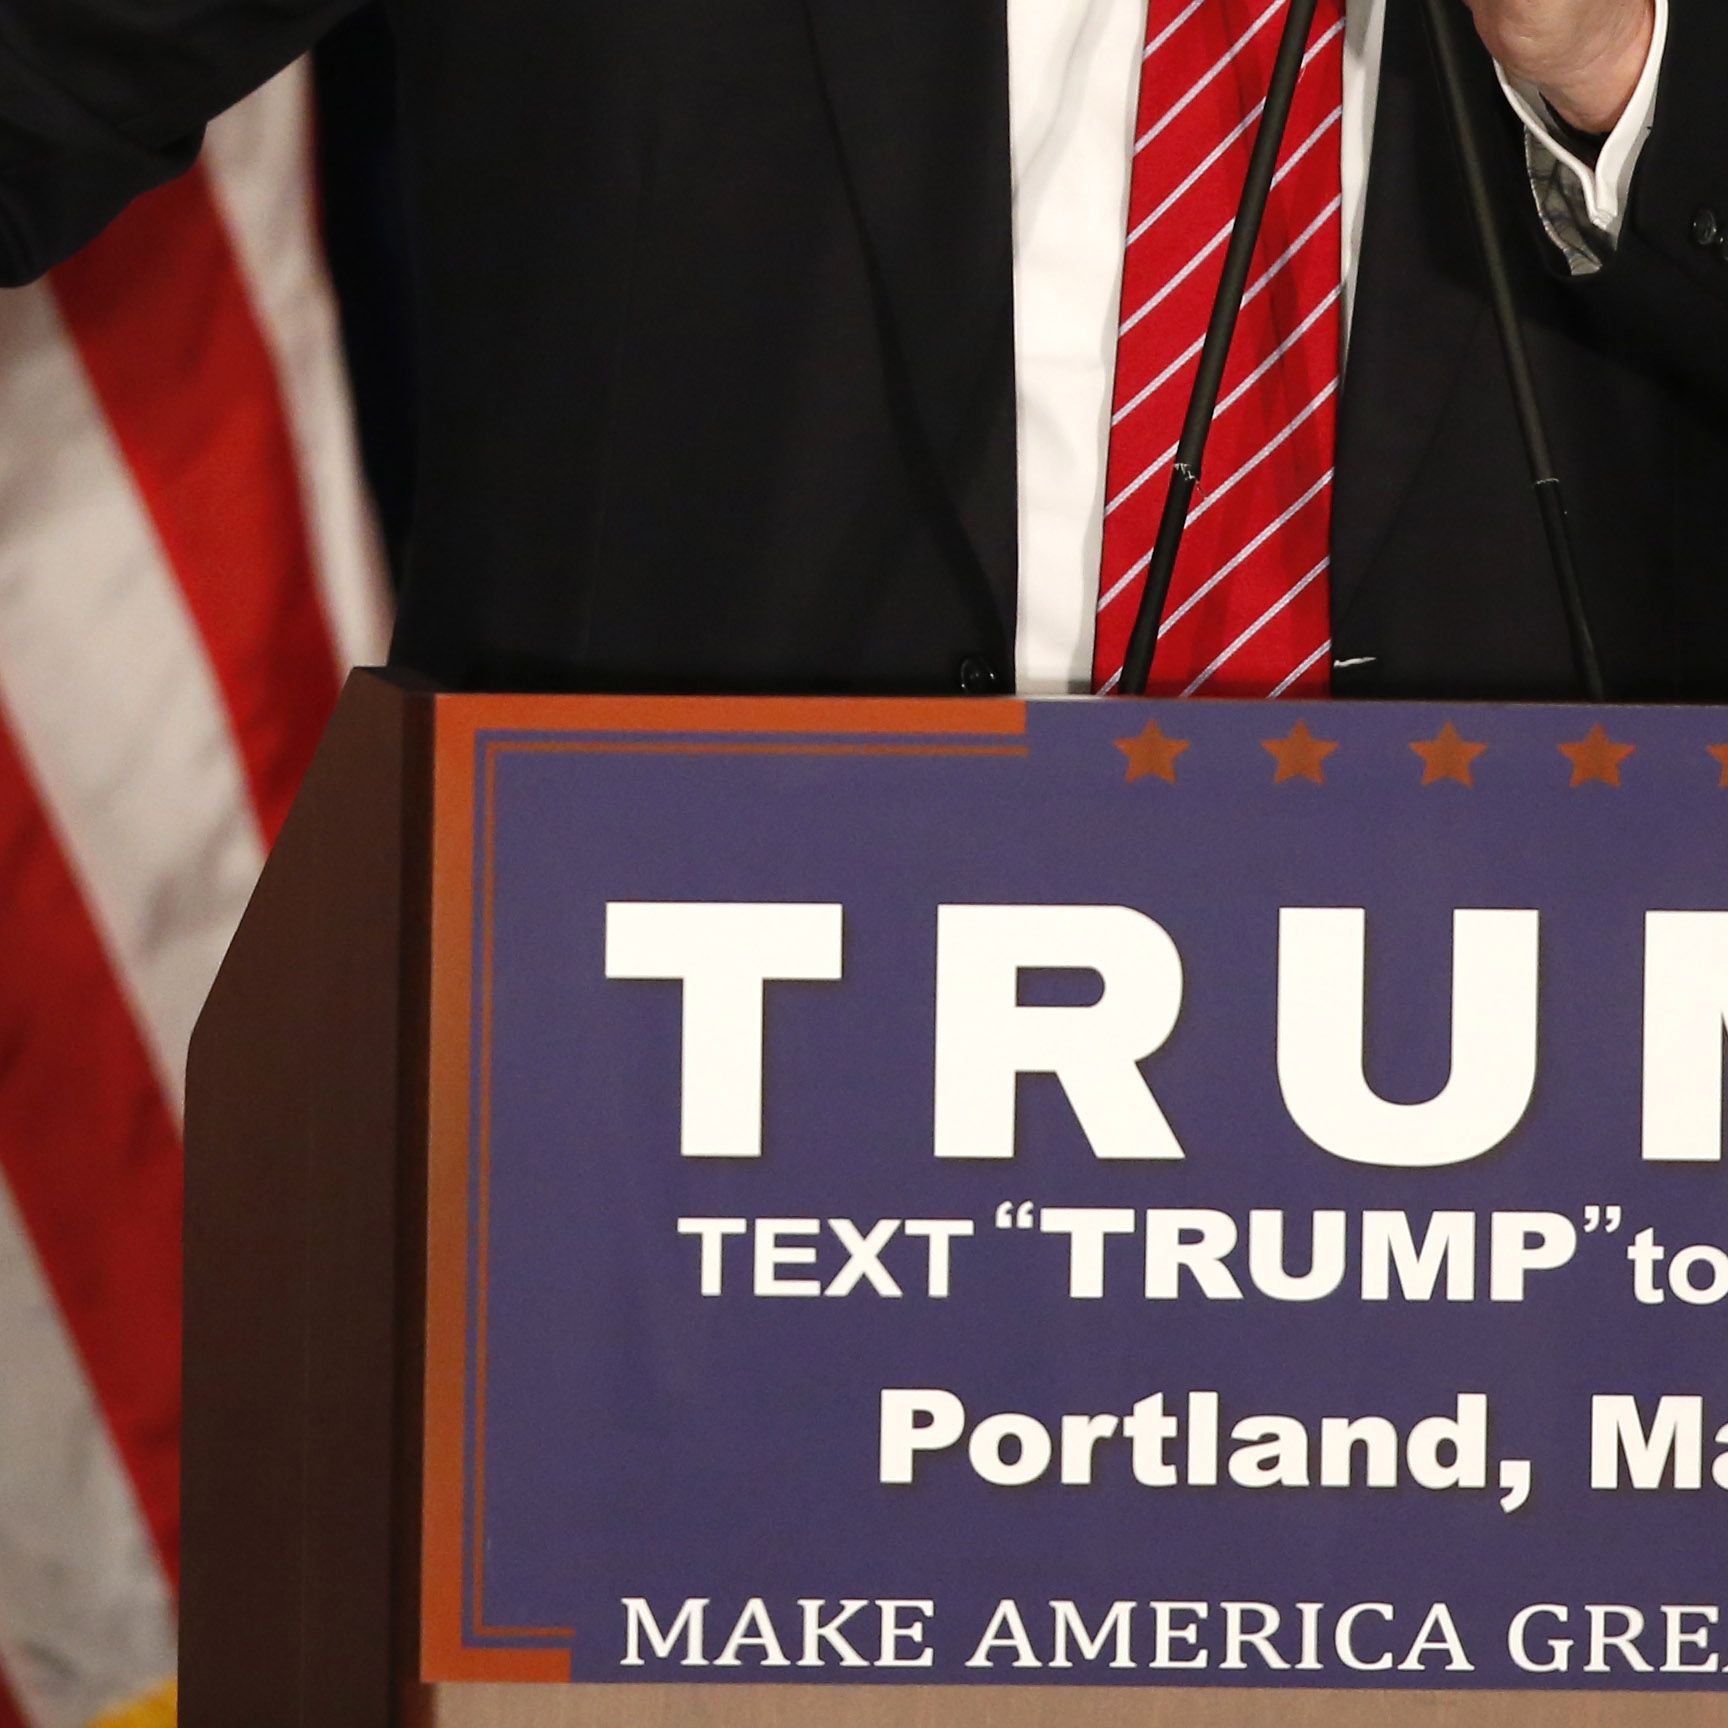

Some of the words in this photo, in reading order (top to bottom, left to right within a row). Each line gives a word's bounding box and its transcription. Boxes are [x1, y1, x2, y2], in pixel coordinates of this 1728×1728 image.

[676, 1217, 975, 1298] TEXT
[879, 1388, 1531, 1513] Portland,
[619, 1597, 934, 1668] MAKE
[964, 1599, 1475, 1671] AMERICA
